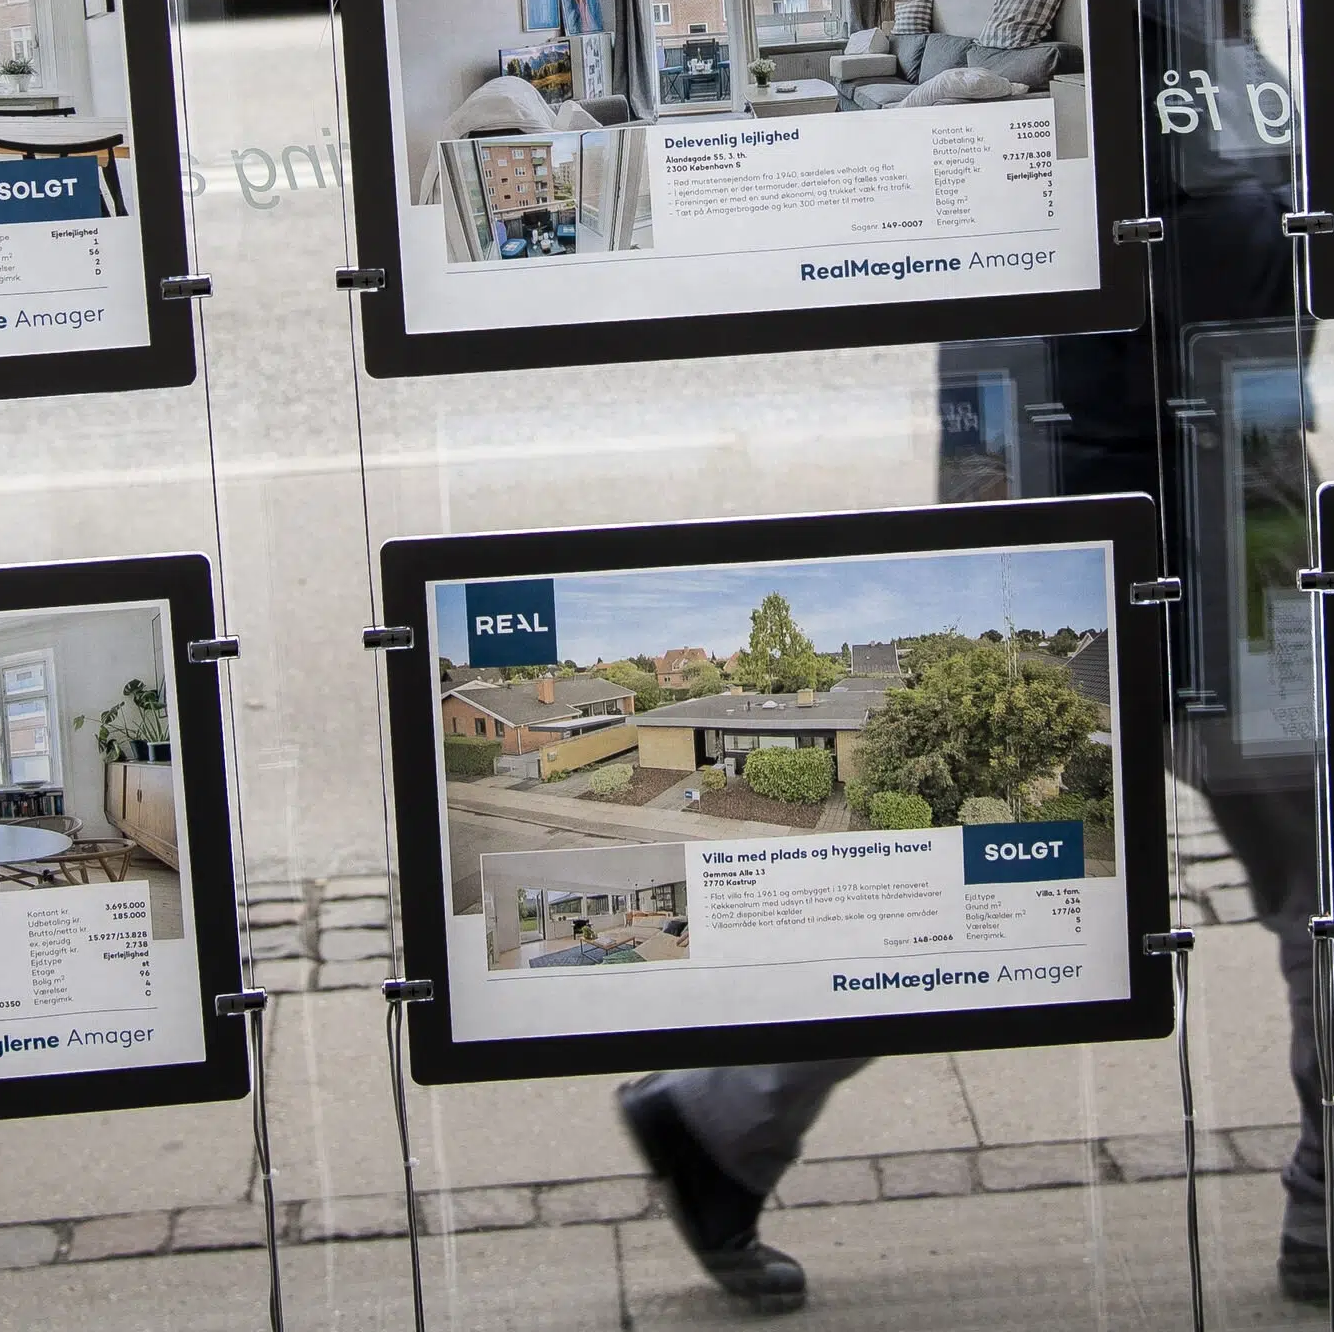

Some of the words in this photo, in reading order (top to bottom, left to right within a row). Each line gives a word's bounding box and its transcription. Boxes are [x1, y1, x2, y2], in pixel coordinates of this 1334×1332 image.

[1009, 119, 1050, 130] 2.195.000
[1017, 130, 1050, 139] 110.000
[664, 132, 737, 149] Delevenlig
[740, 128, 799, 146] lejlighed
[881, 219, 923, 229] 149-0007
[800, 255, 961, 281] RealMæglerne
[968, 250, 1056, 270] Amager
[14, 308, 104, 329] Amager
[476, 613, 549, 635] REAL
[701, 852, 733, 864] Villa
[737, 849, 766, 862] med
[770, 847, 807, 864] plads
[810, 848, 828, 860] og
[831, 841, 891, 859] hyggelig
[894, 840, 931, 853] have!
[984, 840, 1063, 861] SOLGT
[703, 879, 724, 887] 2770
[725, 878, 756, 886] Kastrup
[105, 900, 145, 911] 3.695.000
[112, 910, 146, 920] 185.000
[913, 933, 953, 944] 148-0066
[832, 967, 990, 991] RealMæglerne
[996, 964, 1083, 984] Amager
[66, 1028, 154, 1048] Amager
